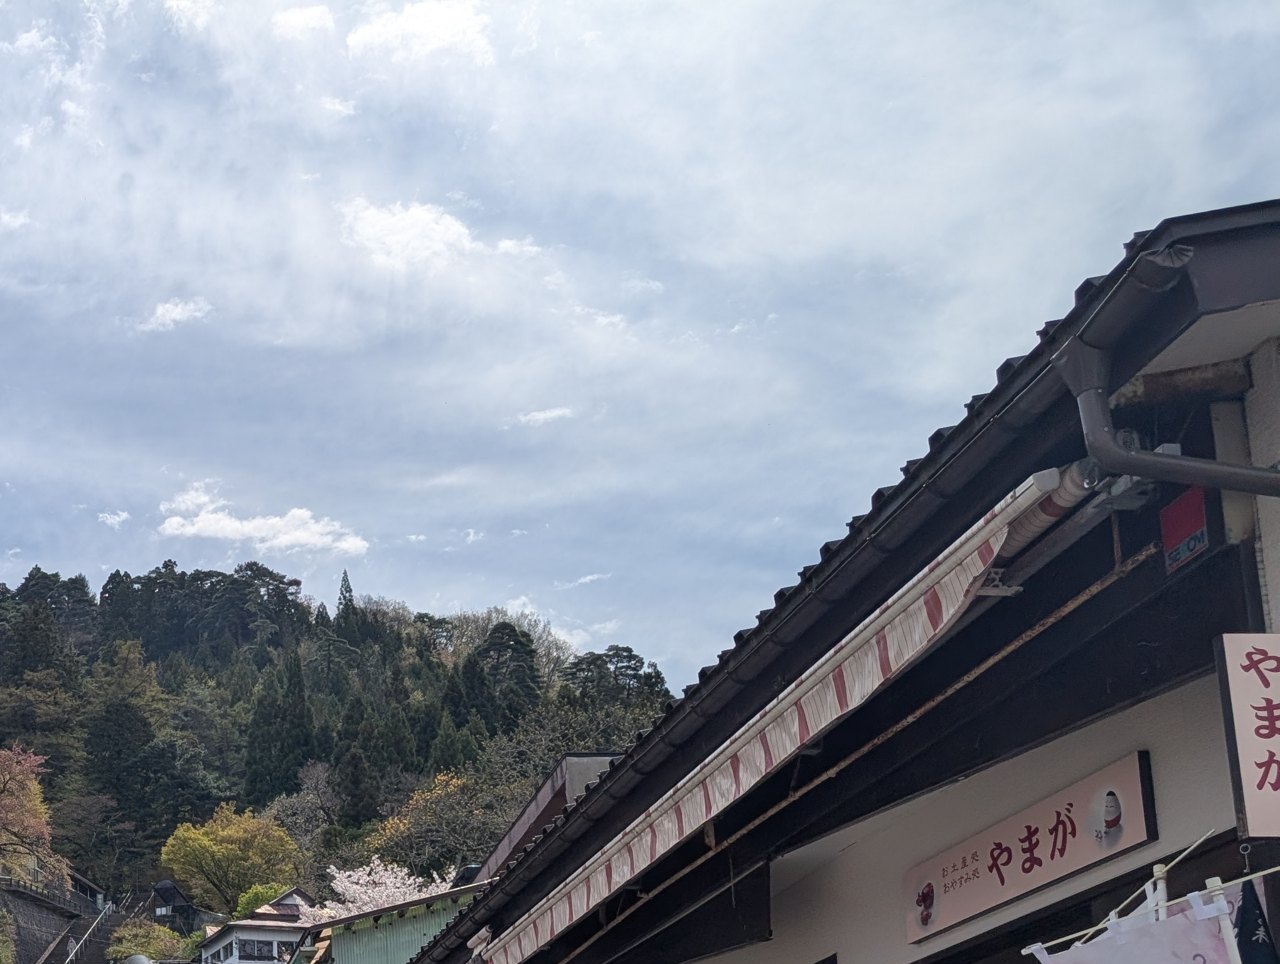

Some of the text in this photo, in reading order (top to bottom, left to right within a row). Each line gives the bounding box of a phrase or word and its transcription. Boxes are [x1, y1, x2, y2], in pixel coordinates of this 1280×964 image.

[1169, 530, 1204, 560] SEOM
[988, 803, 1077, 886] やまが
[942, 851, 980, 878] お土産処
[943, 867, 981, 895] おやすみ処
